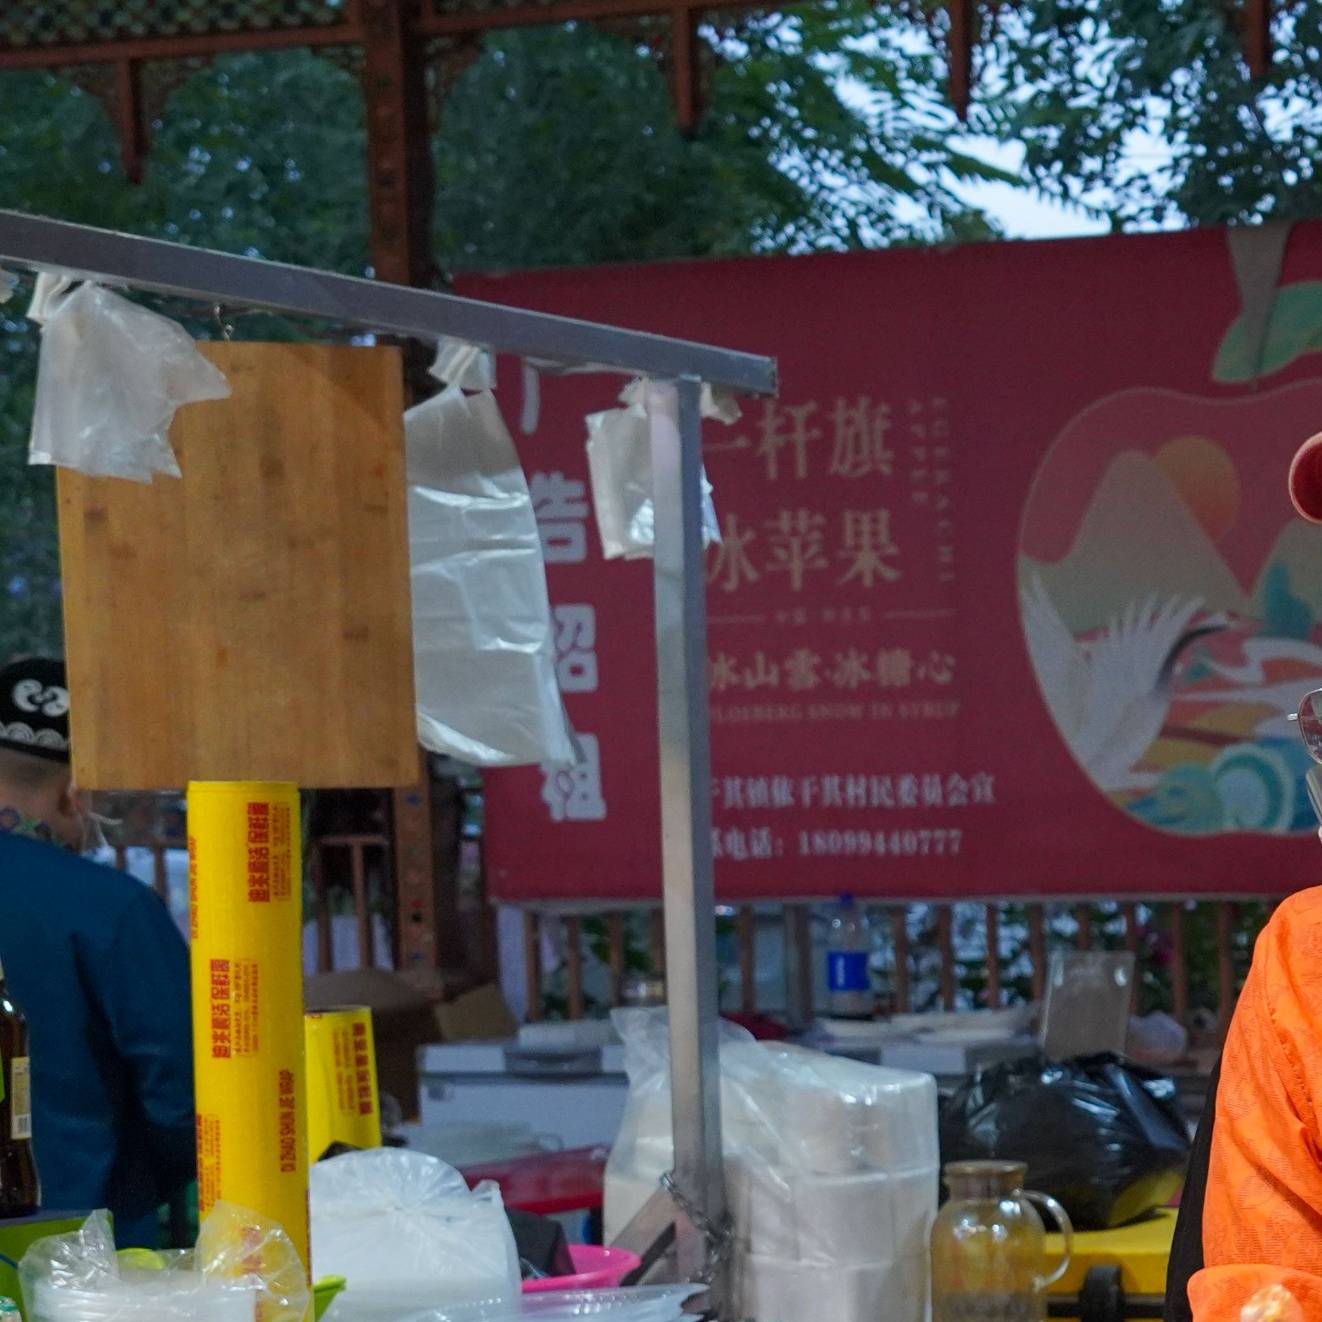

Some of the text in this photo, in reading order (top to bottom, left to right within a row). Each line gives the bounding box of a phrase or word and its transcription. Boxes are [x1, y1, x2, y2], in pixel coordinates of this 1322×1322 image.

[702, 396, 895, 480] 一杆旗
[279, 1069, 296, 1173] DI ZHAO SHUN JIE WRAP
